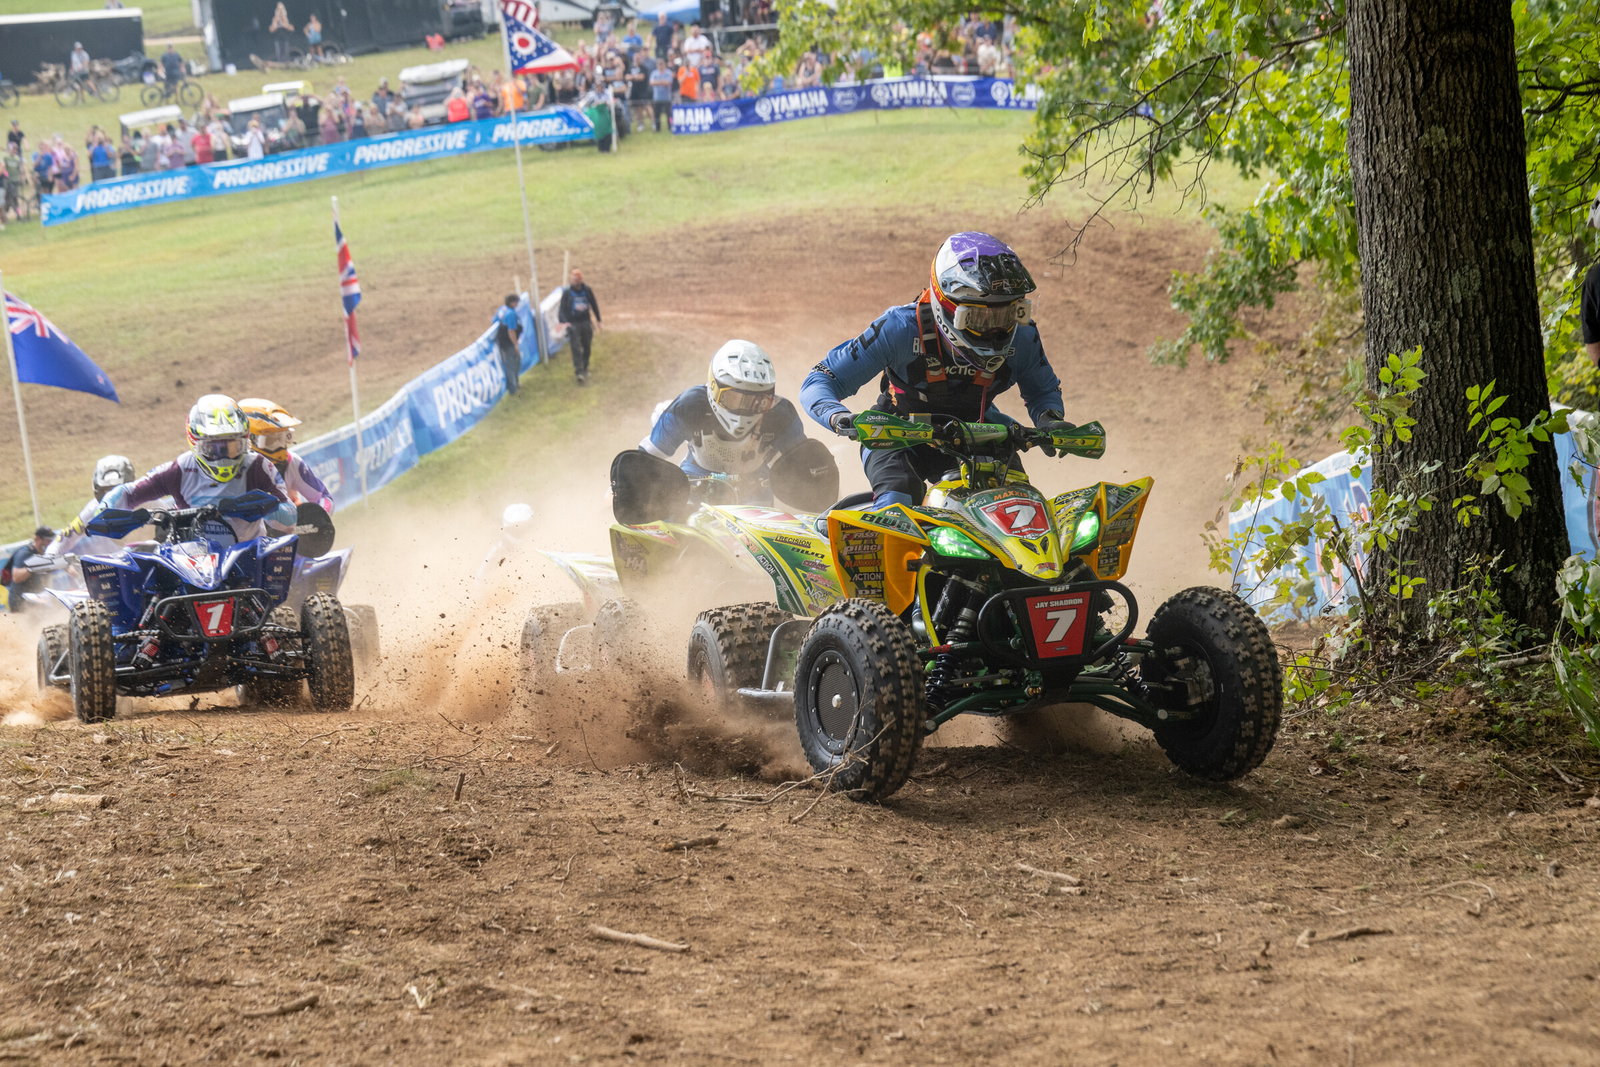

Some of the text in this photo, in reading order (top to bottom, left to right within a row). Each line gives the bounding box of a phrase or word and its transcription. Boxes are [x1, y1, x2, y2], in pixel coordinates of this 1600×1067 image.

[770, 89, 829, 113] YAMAHA
[888, 80, 948, 100] YAMAHA
[492, 117, 591, 143] PROGRE
[353, 128, 468, 166] PROGRESSIVE
[213, 152, 330, 189] PROGRESSIVE
[75, 175, 190, 214] PROGRESSIVE
[744, 370, 766, 380] FLY
[871, 425, 884, 438] 7
[993, 490, 1029, 502] MAXXIS
[1004, 504, 1037, 530] 7
[757, 554, 777, 576] ACTION
[852, 572, 881, 581] ACTION
[1049, 598, 1083, 607] SHADRON
[206, 604, 225, 630] 1
[1045, 609, 1077, 643] 7
